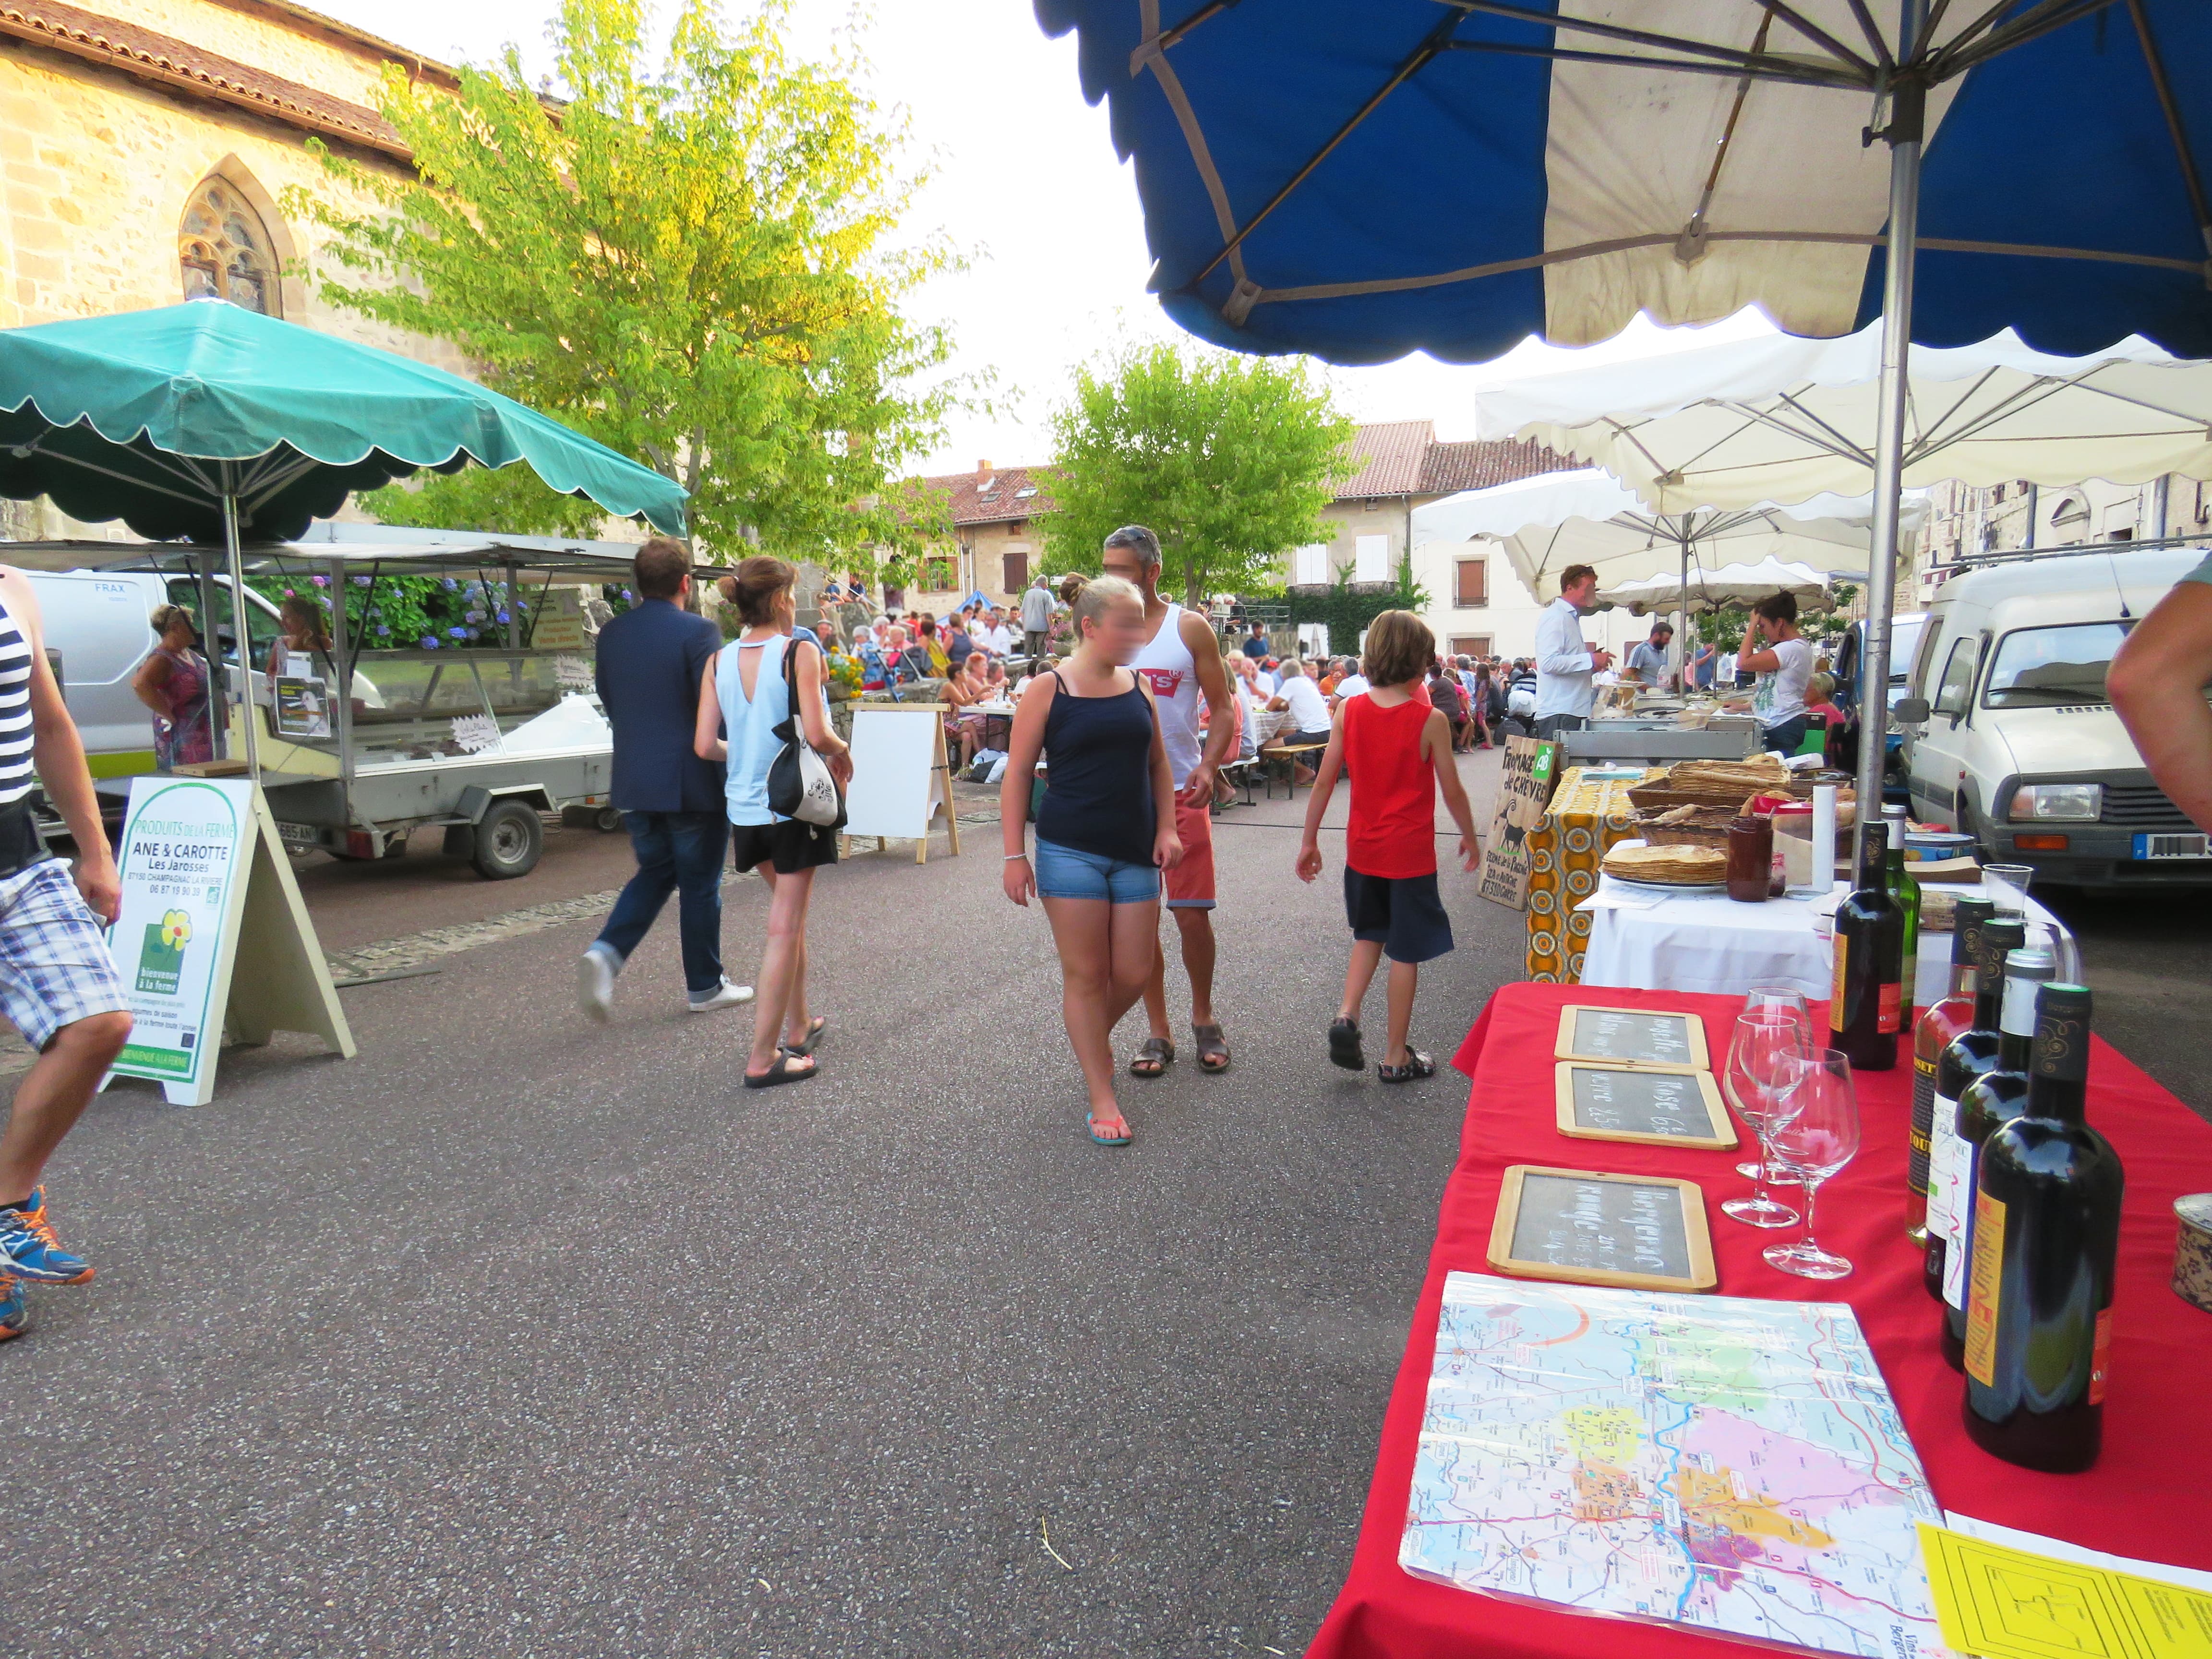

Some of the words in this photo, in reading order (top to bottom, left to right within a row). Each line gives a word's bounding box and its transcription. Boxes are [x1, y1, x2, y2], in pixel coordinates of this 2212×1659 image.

[95, 583, 125, 592] FRAX
[1536, 754, 1549, 771] AB
[135, 819, 183, 836] PRODUITS
[205, 822, 235, 838] FERME
[132, 842, 159, 856] ANE
[162, 843, 171, 857] &
[174, 844, 228, 860] CAROTTE
[148, 857, 166, 870] Les
[168, 859, 209, 873] Jarosses
[147, 873, 191, 884] CHAMPAGNAC
[149, 884, 159, 893] 06
[141, 967, 178, 980] bienvenue
[155, 980, 176, 992] ferme
[1904, 1635, 1918, 1653] Vins
